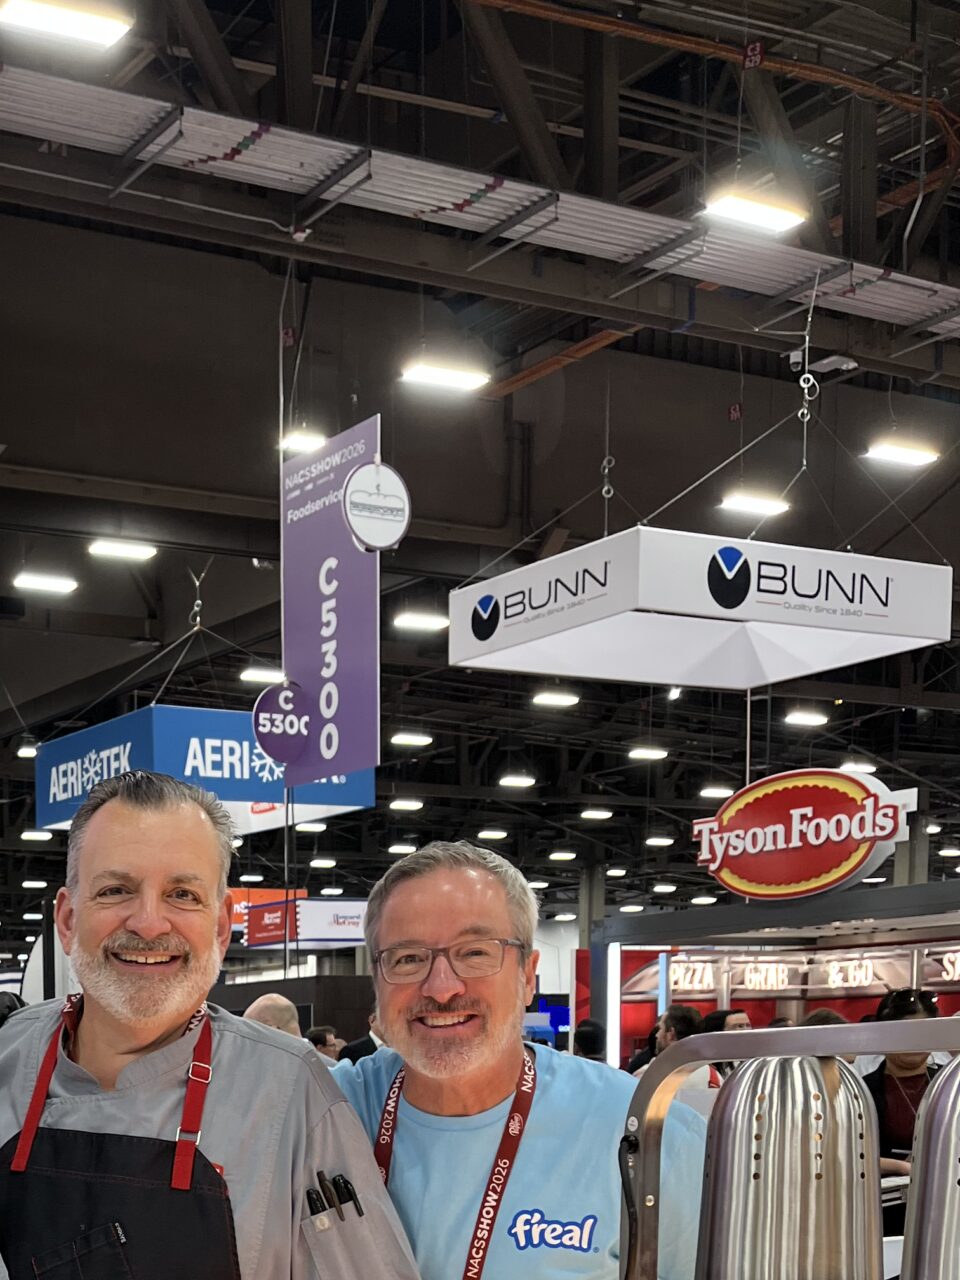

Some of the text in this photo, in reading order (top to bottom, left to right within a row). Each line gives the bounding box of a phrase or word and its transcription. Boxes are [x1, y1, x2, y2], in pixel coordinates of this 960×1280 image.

[503, 561, 608, 620] BUNN
[757, 561, 890, 607] BUNN
[278, 690, 294, 710] C
[693, 796, 896, 872] Tyson Foods
[670, 962, 715, 991] PIZZA
[744, 962, 789, 990] GRAB
